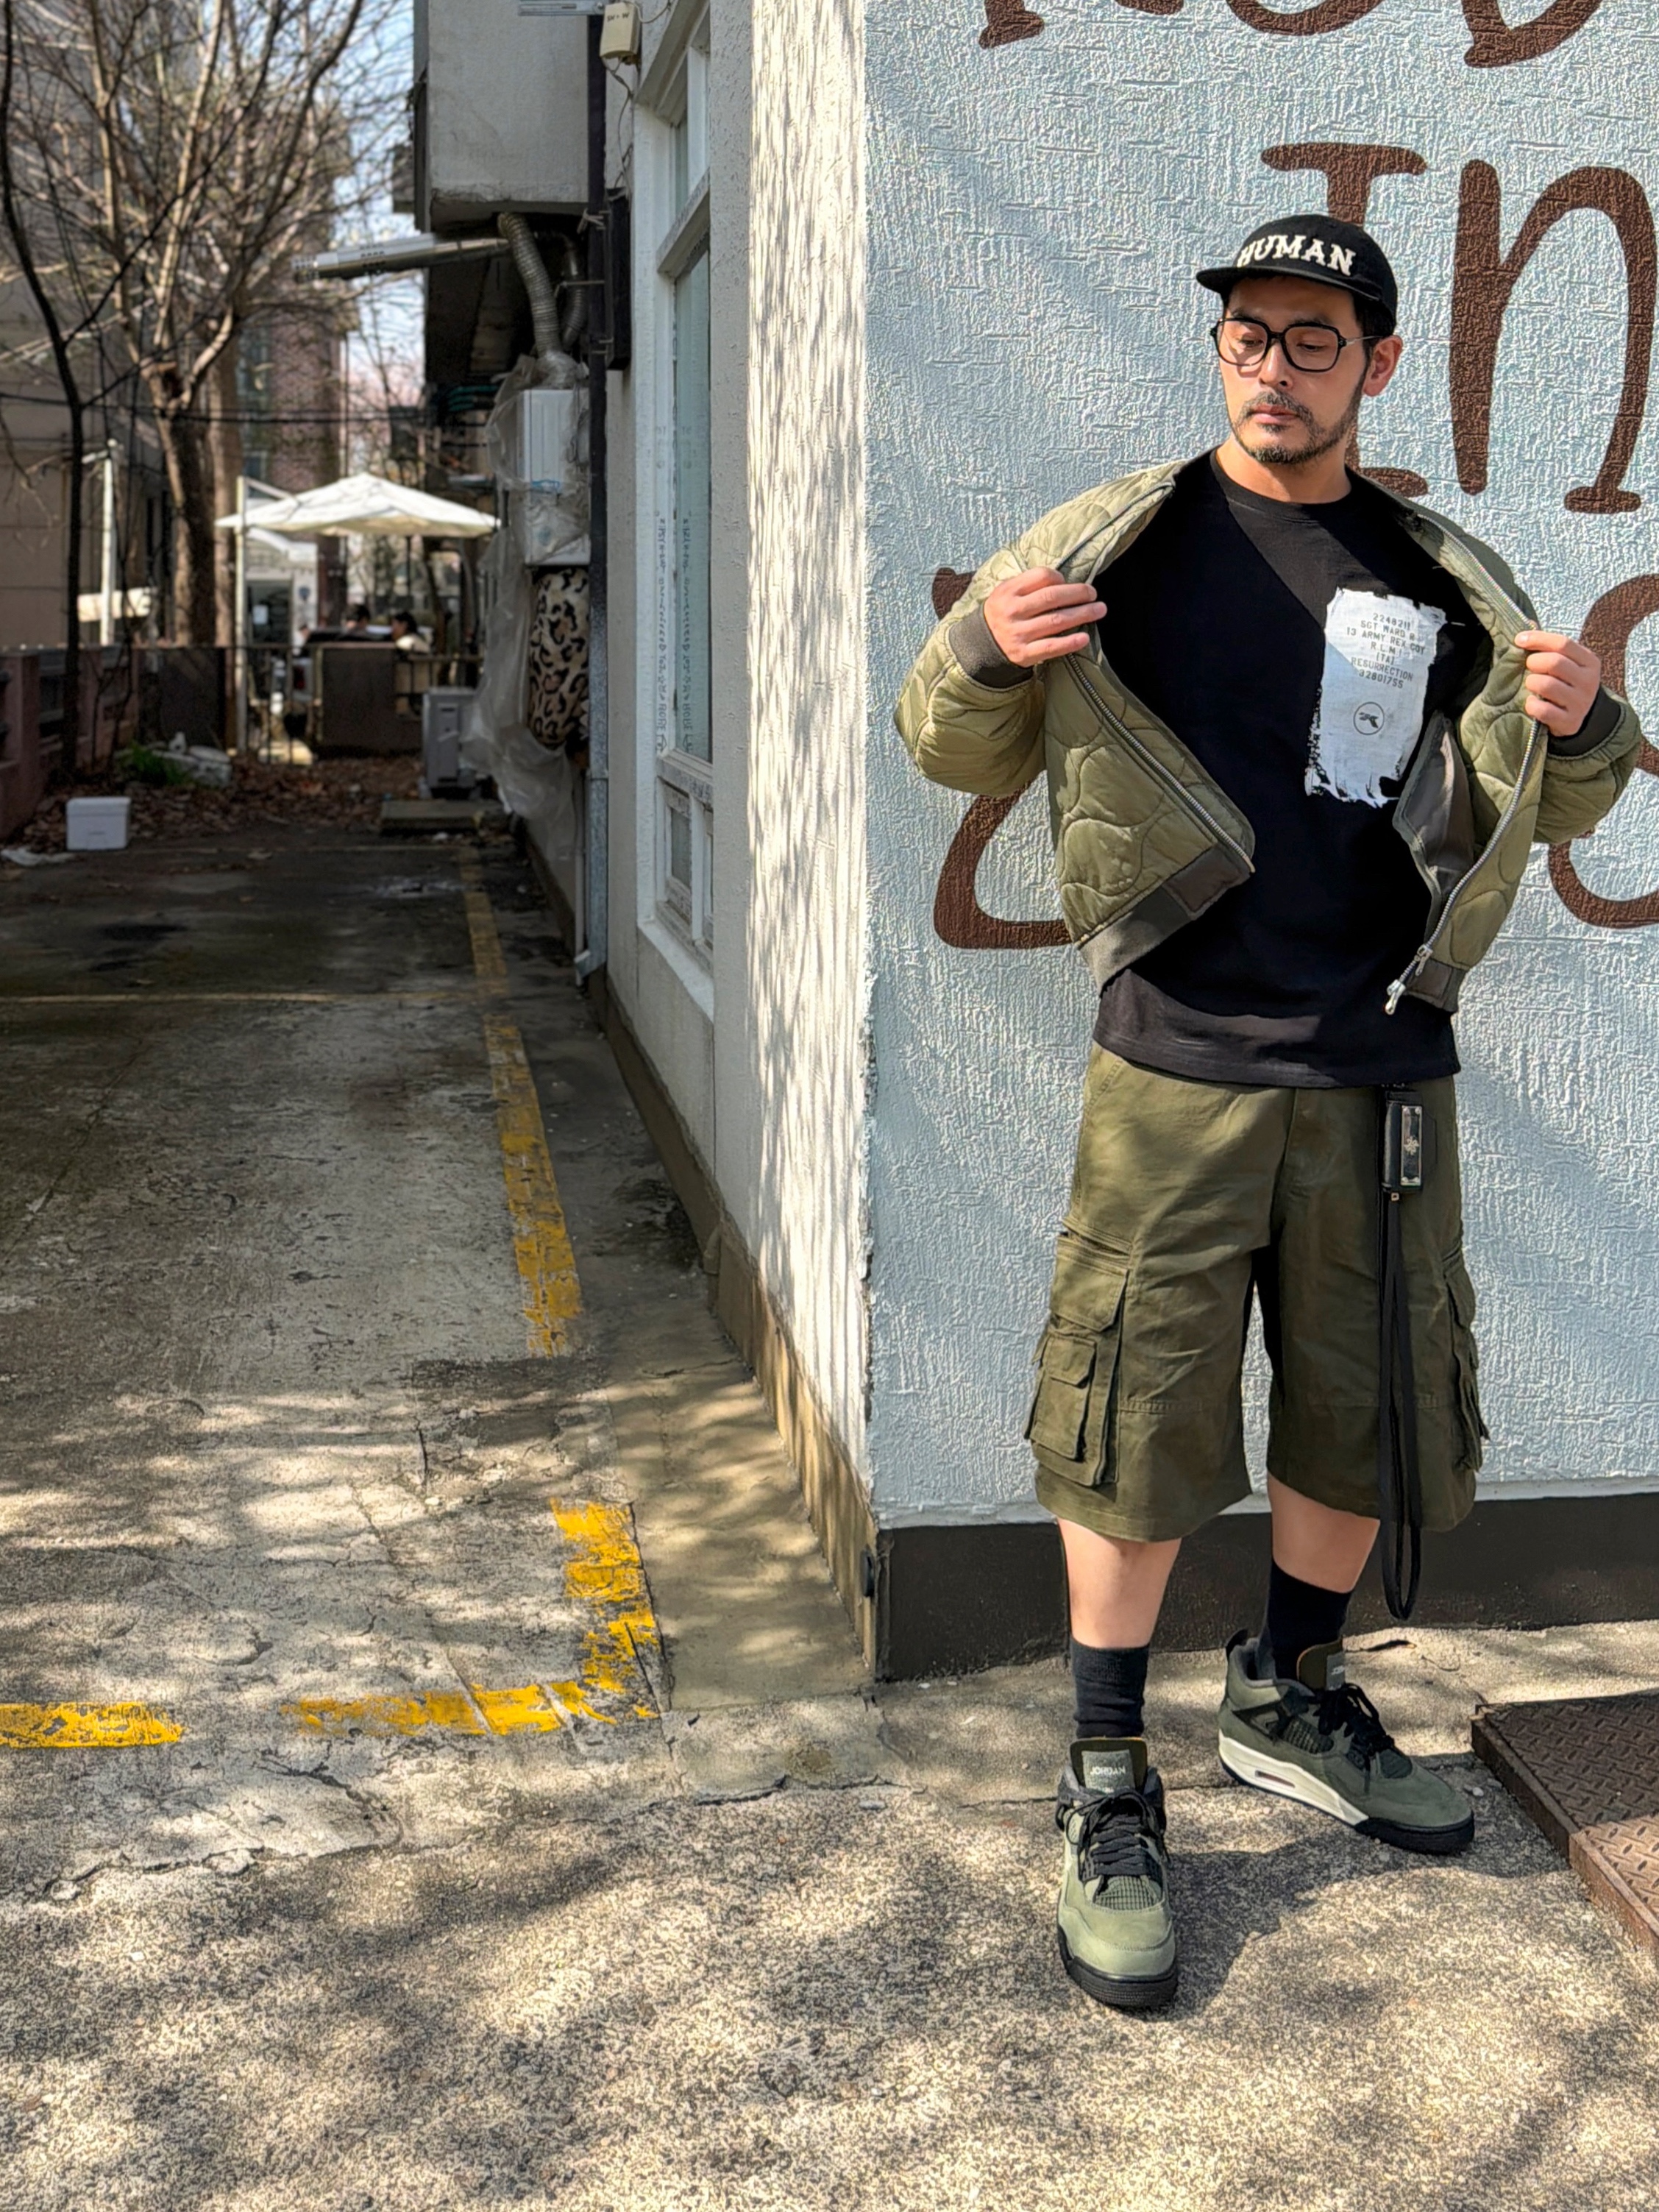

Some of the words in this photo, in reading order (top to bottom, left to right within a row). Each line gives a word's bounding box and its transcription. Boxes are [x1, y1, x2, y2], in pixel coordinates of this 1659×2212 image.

[1237, 235, 1356, 276] HUMAN
[1346, 626, 1357, 637] 13
[1362, 630, 1386, 642] ARMY
[1390, 636, 1407, 648] REX
[1410, 642, 1426, 655] COY
[1360, 620, 1378, 631] SGT
[1383, 625, 1406, 638] WARD
[1351, 656, 1414, 681] RESURRECTION
